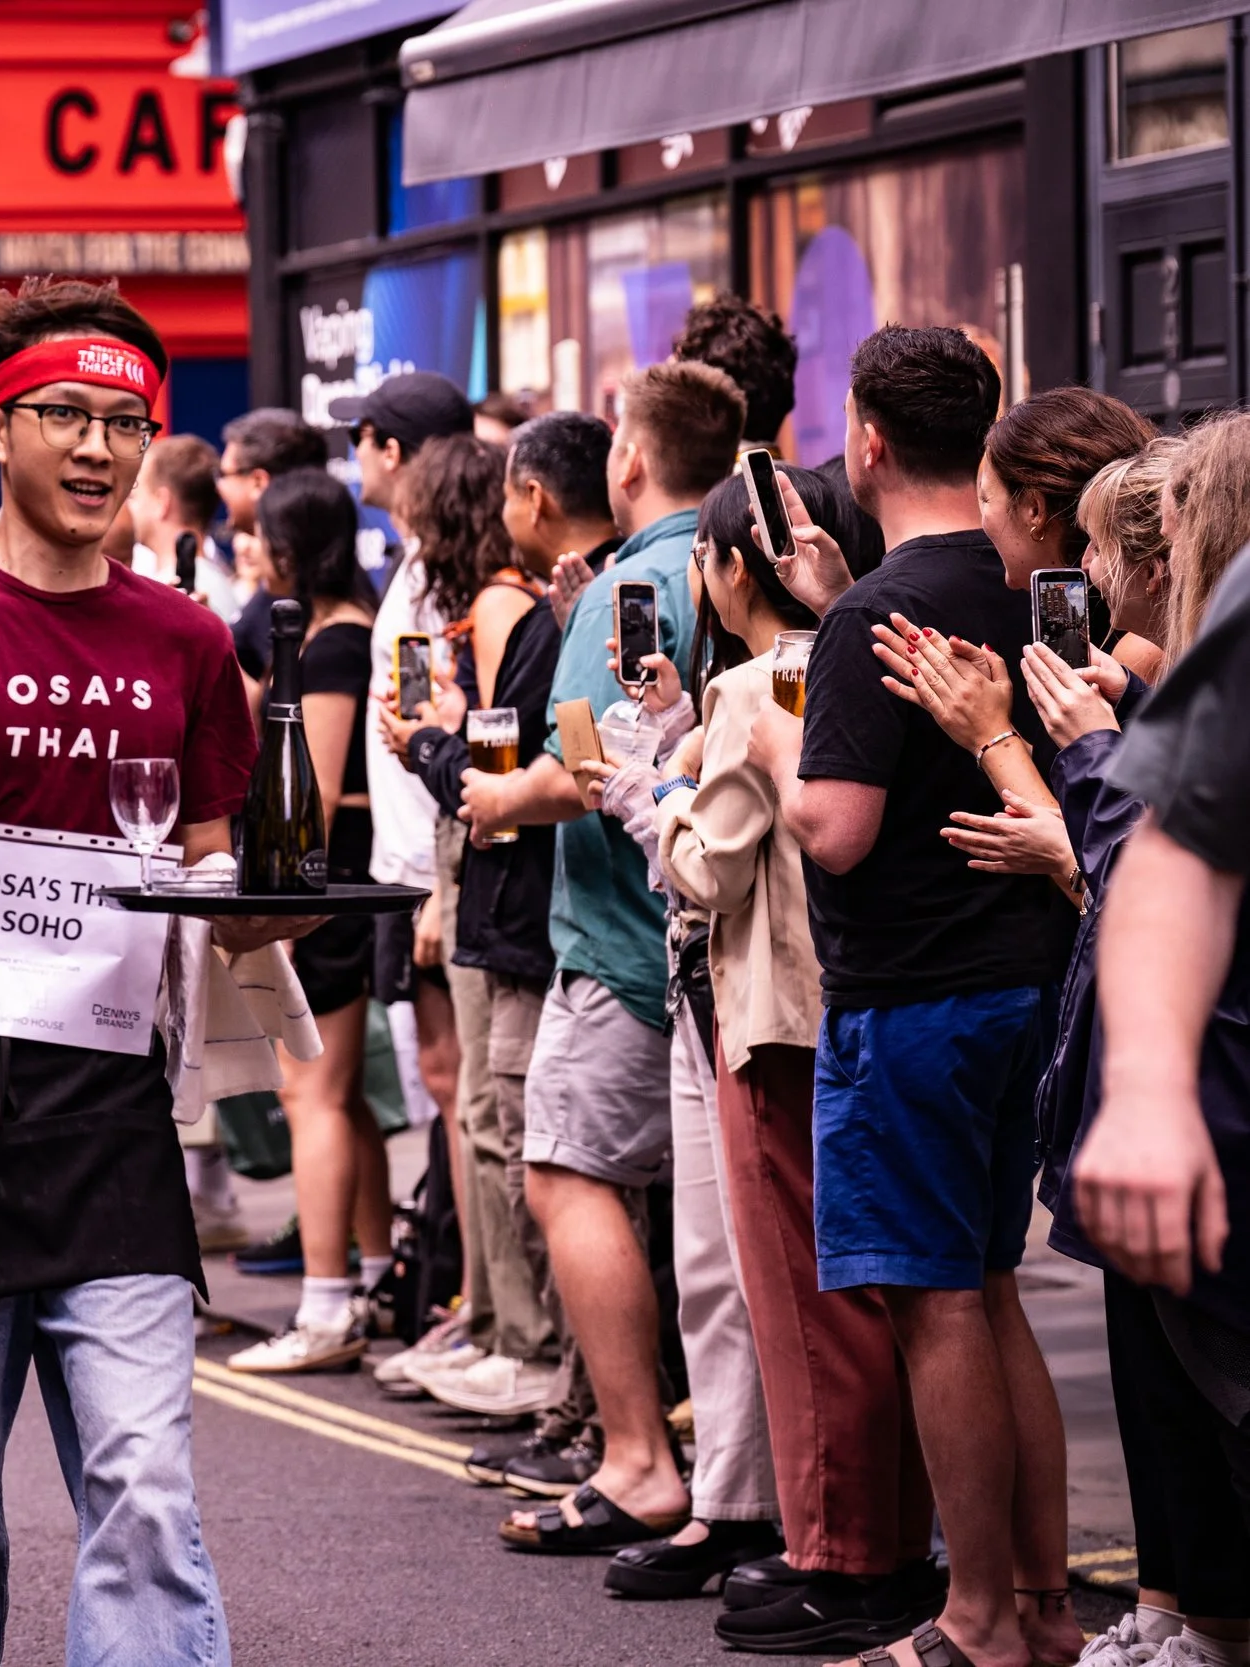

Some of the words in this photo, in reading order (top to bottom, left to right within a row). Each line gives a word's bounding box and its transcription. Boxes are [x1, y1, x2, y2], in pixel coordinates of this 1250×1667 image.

[78, 350, 125, 367] TRIPLE
[77, 361, 124, 377] THREAT
[6, 727, 119, 760] THAI
[0, 910, 83, 941] SOHO
[31, 1018, 66, 1031] HOUSE
[95, 1018, 135, 1030] BRANDS
